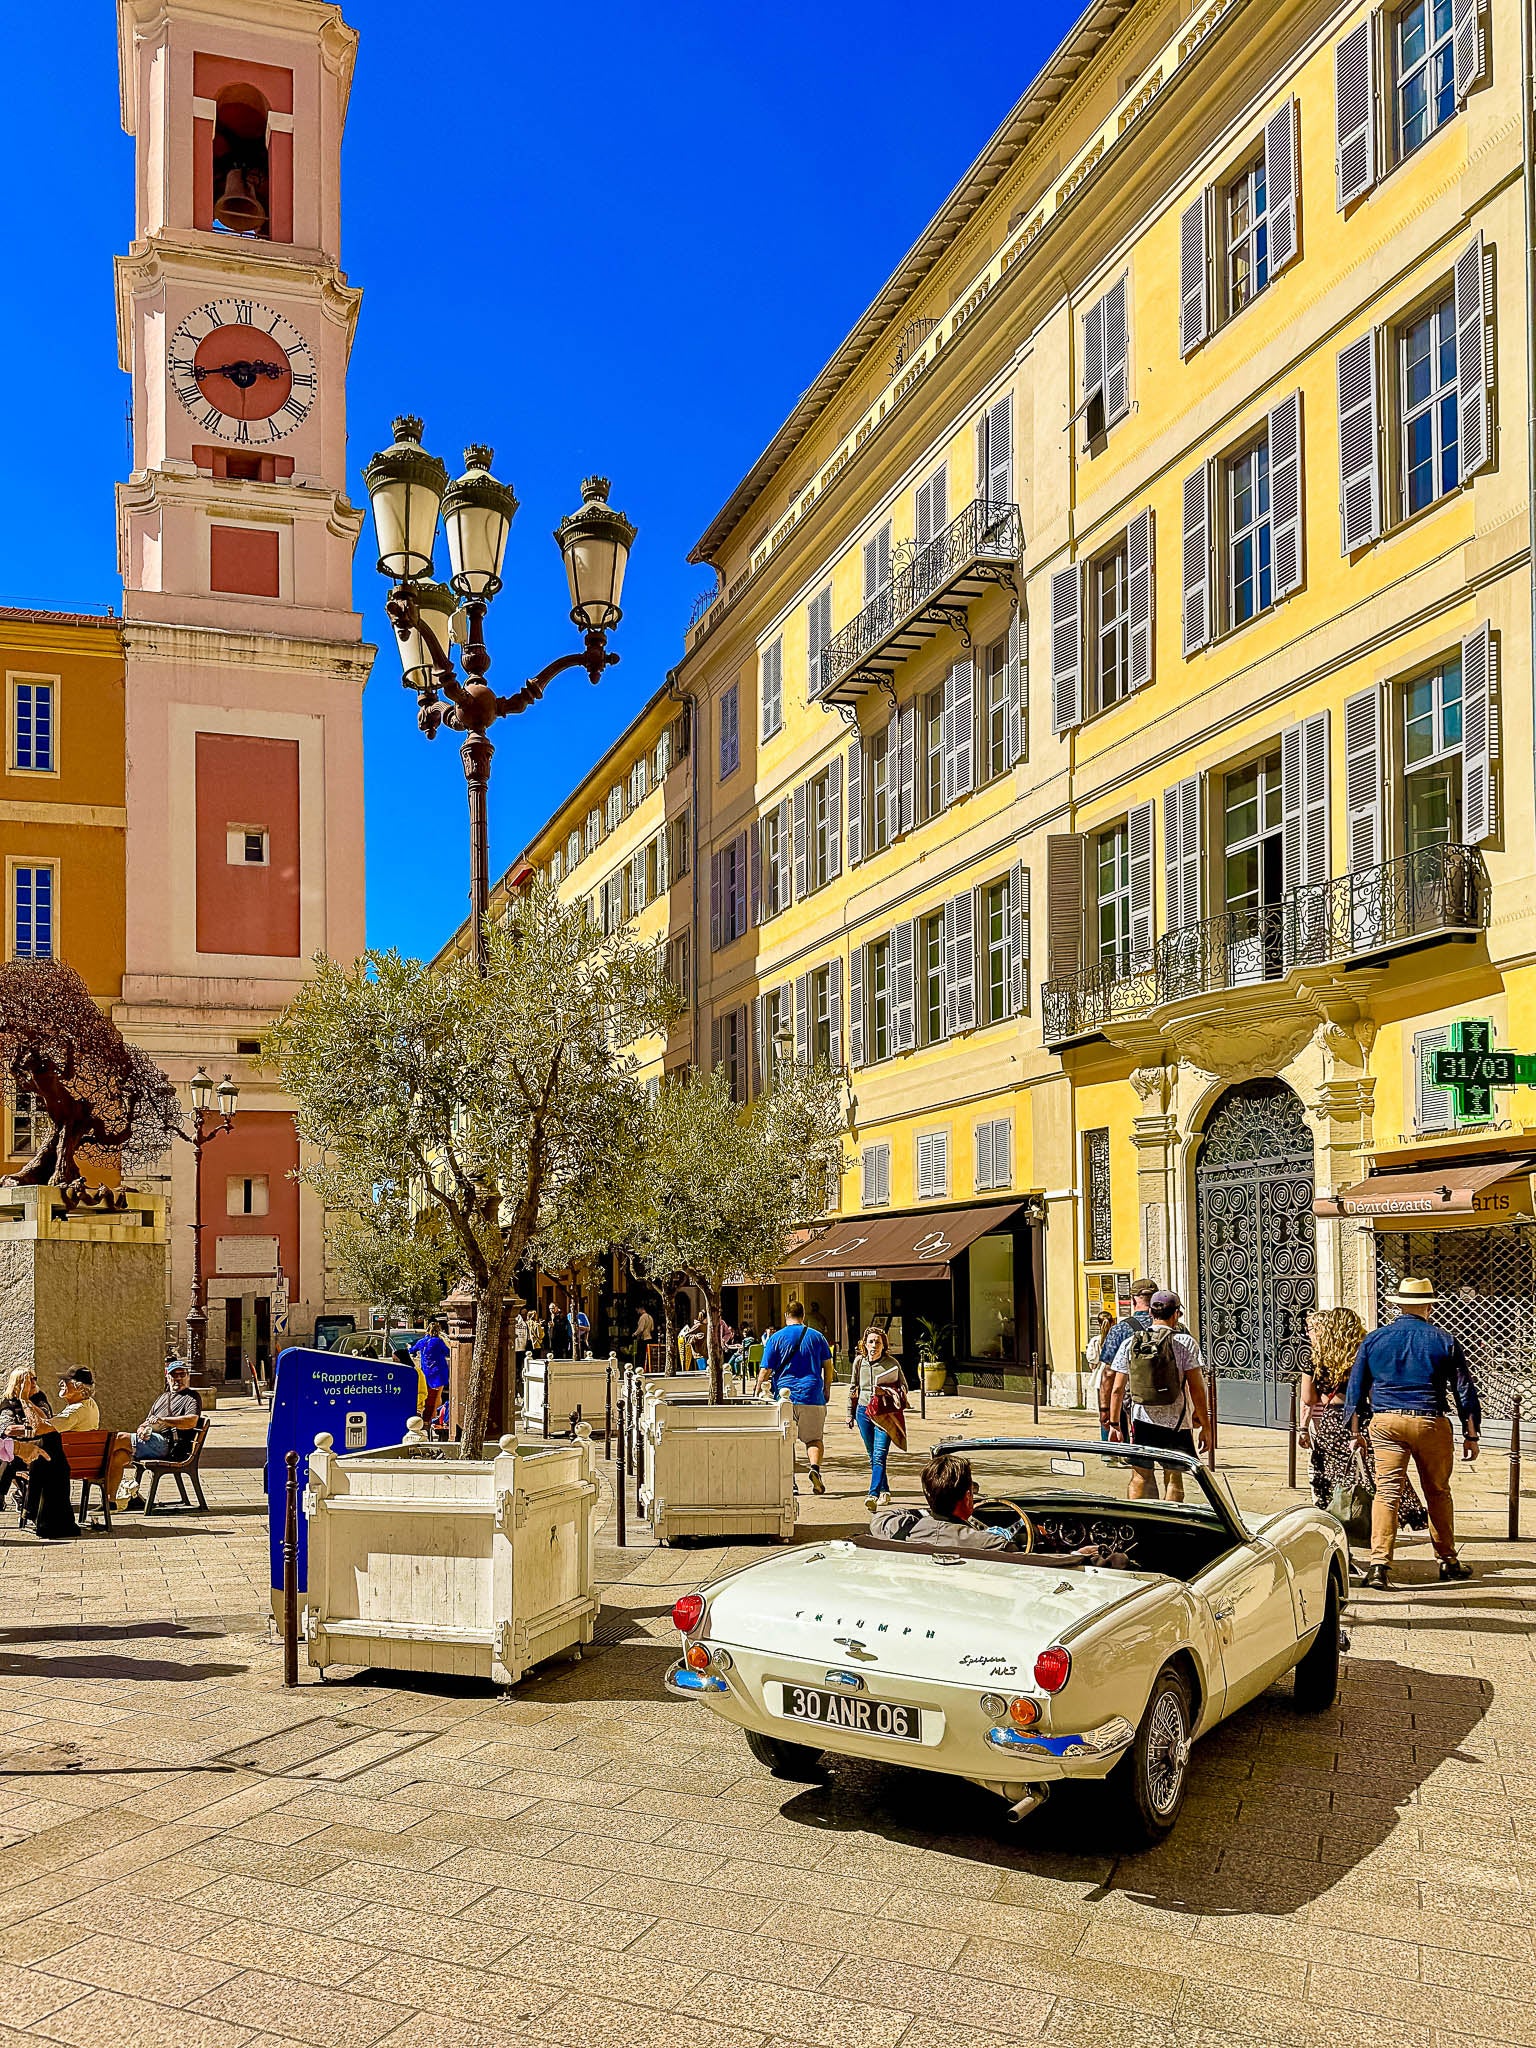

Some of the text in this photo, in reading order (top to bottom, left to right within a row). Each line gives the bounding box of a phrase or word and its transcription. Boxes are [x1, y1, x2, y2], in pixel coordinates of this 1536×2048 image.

[204, 307, 225, 328] XI
[235, 305, 253, 325] XII
[266, 317, 280, 336] I
[180, 327, 202, 347] X
[284, 342, 305, 358] II
[293, 372, 312, 388] III
[236, 421, 249, 440] VI
[268, 418, 282, 437] V
[1442, 1056, 1509, 1079] 31/03
[1345, 1200, 1432, 1214] Dézirdézarts
[323, 1387, 341, 1395] vos
[343, 1384, 383, 1395] déchets
[795, 1610, 936, 1639] TRIUMPH
[792, 1688, 908, 1736] 30 ANR 06
